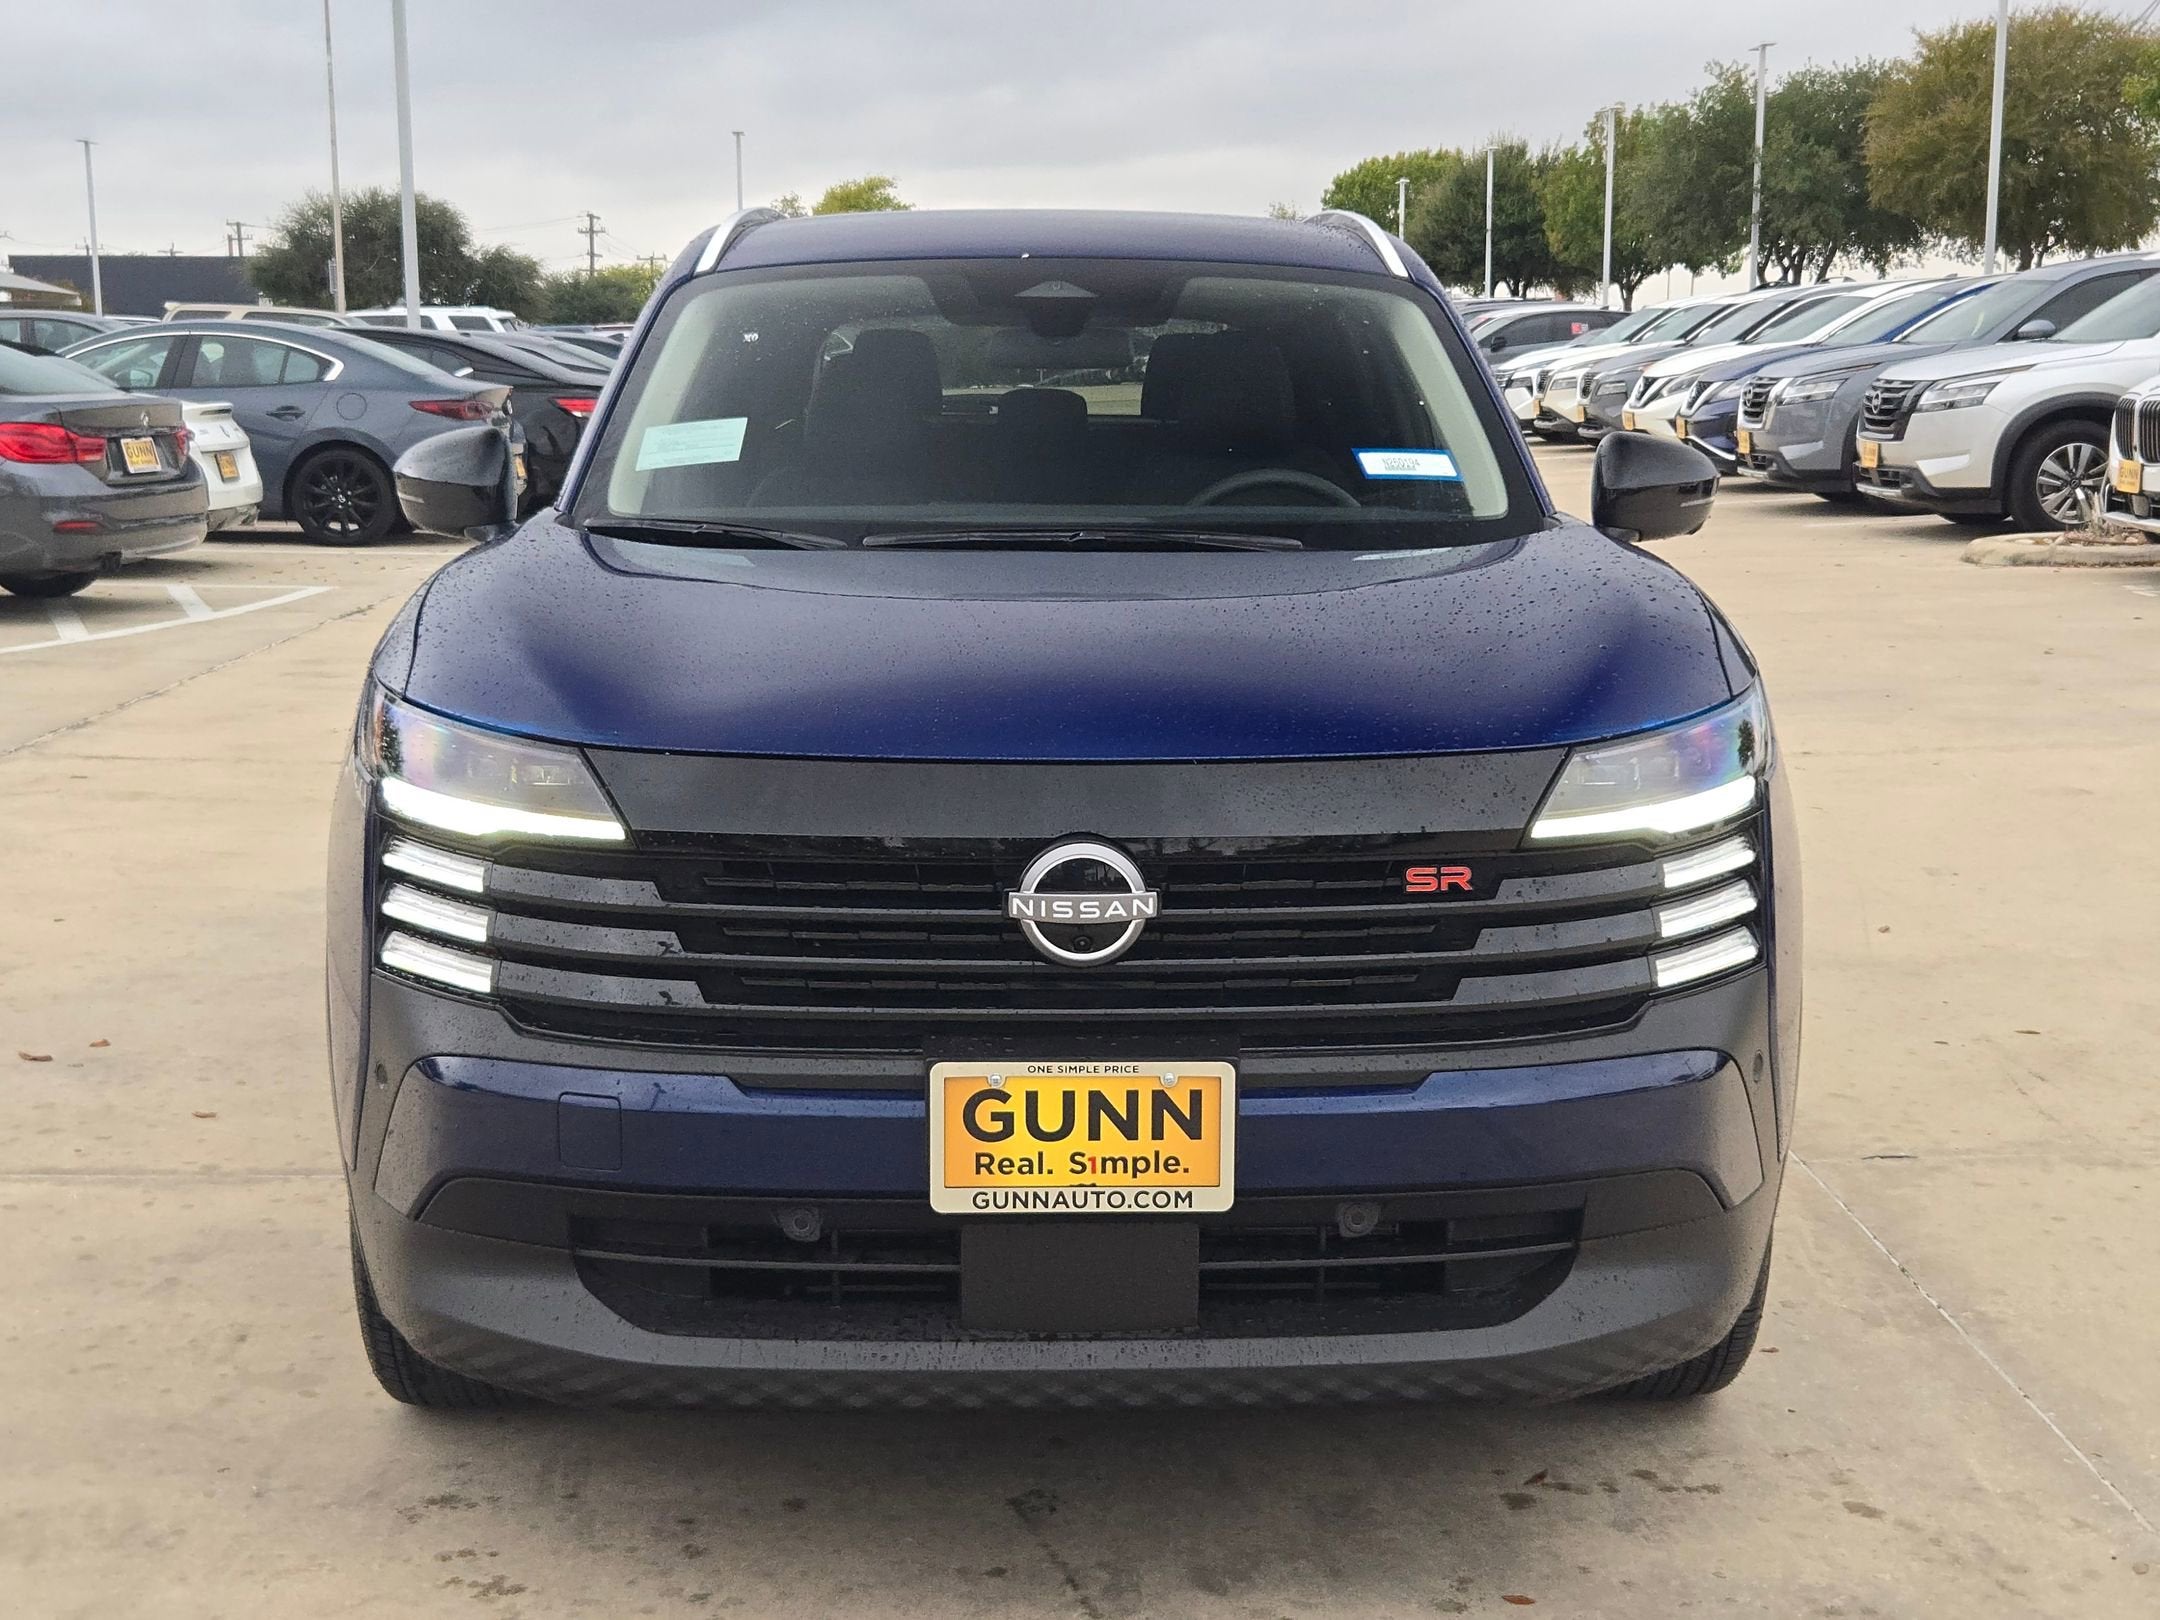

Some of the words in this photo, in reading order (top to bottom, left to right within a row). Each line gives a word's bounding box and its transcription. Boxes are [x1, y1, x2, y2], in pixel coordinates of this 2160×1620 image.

[1405, 866, 1473, 892] SR
[1012, 897, 1155, 919] NISSAN
[1027, 1065, 1053, 1074] ONE
[1057, 1065, 1100, 1074] SIMPLE
[1104, 1065, 1140, 1074] PRICE
[962, 1088, 1203, 1142] GUNN
[974, 1151, 1054, 1176] Real.
[972, 1190, 1193, 1210] GUNNAUTO.COM
